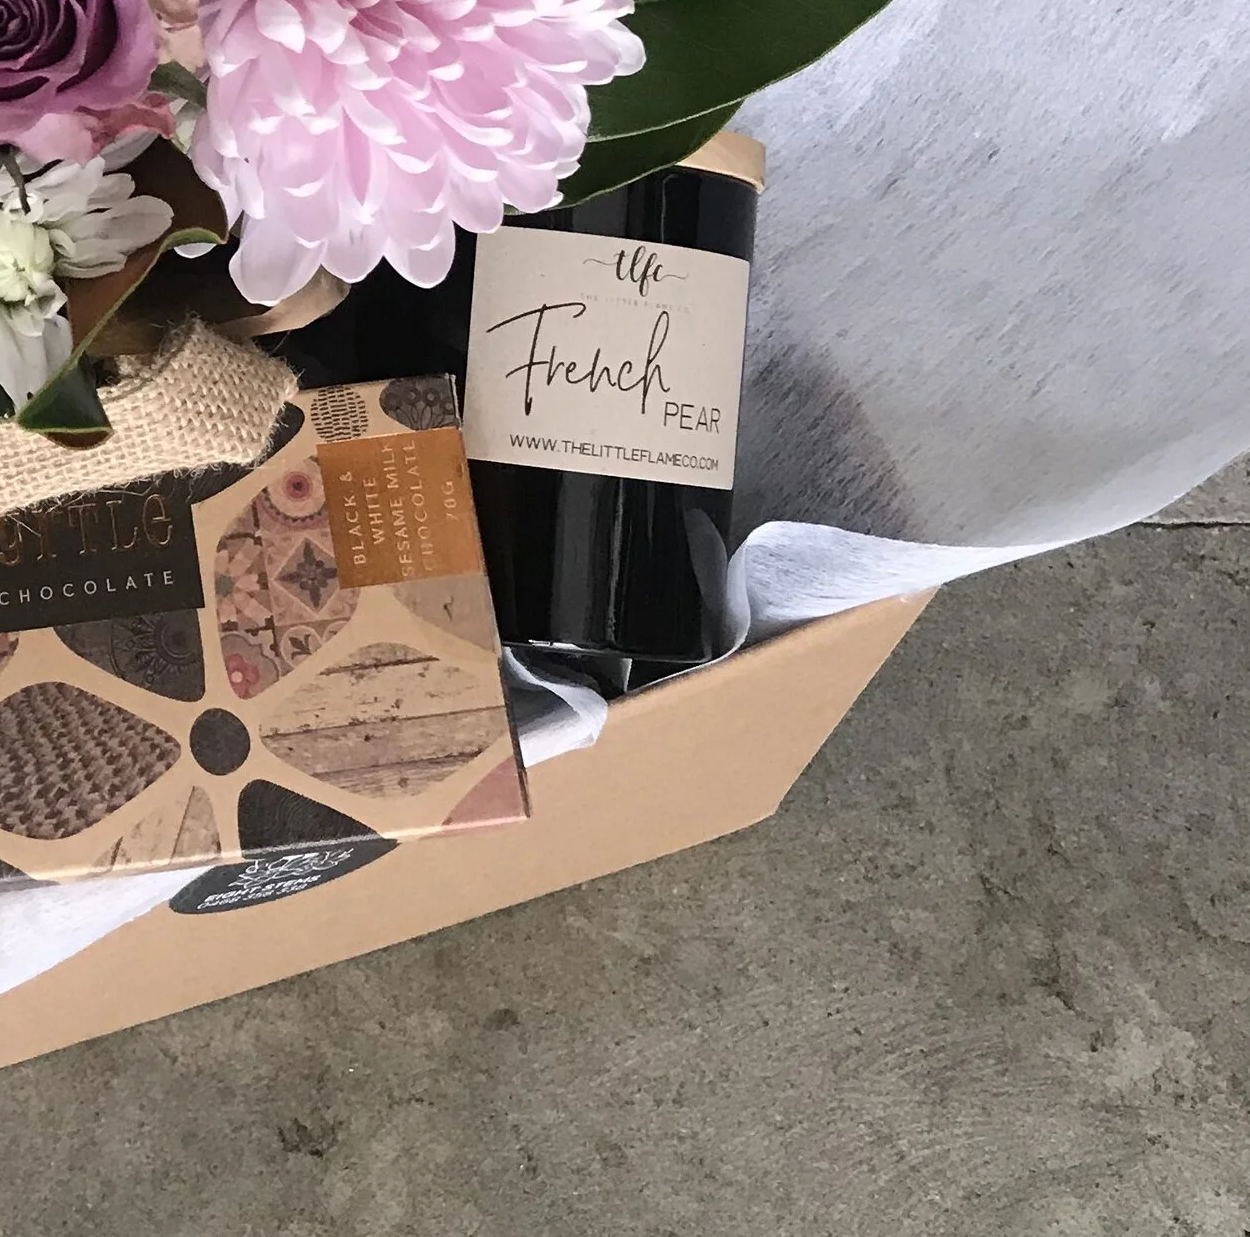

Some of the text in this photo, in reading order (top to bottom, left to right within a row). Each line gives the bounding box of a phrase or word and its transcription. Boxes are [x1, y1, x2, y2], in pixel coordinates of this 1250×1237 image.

[486, 302, 670, 416] French
[509, 433, 719, 472] WWW.THELITTLEFLAMECO.COM
[663, 401, 721, 435] PEAR
[339, 470, 367, 566] BLACK &
[363, 476, 386, 546] WHITE
[381, 441, 415, 578] SESAME MILK
[403, 439, 436, 572] CHOCOLATE
[261, 874, 321, 891] STEMS
